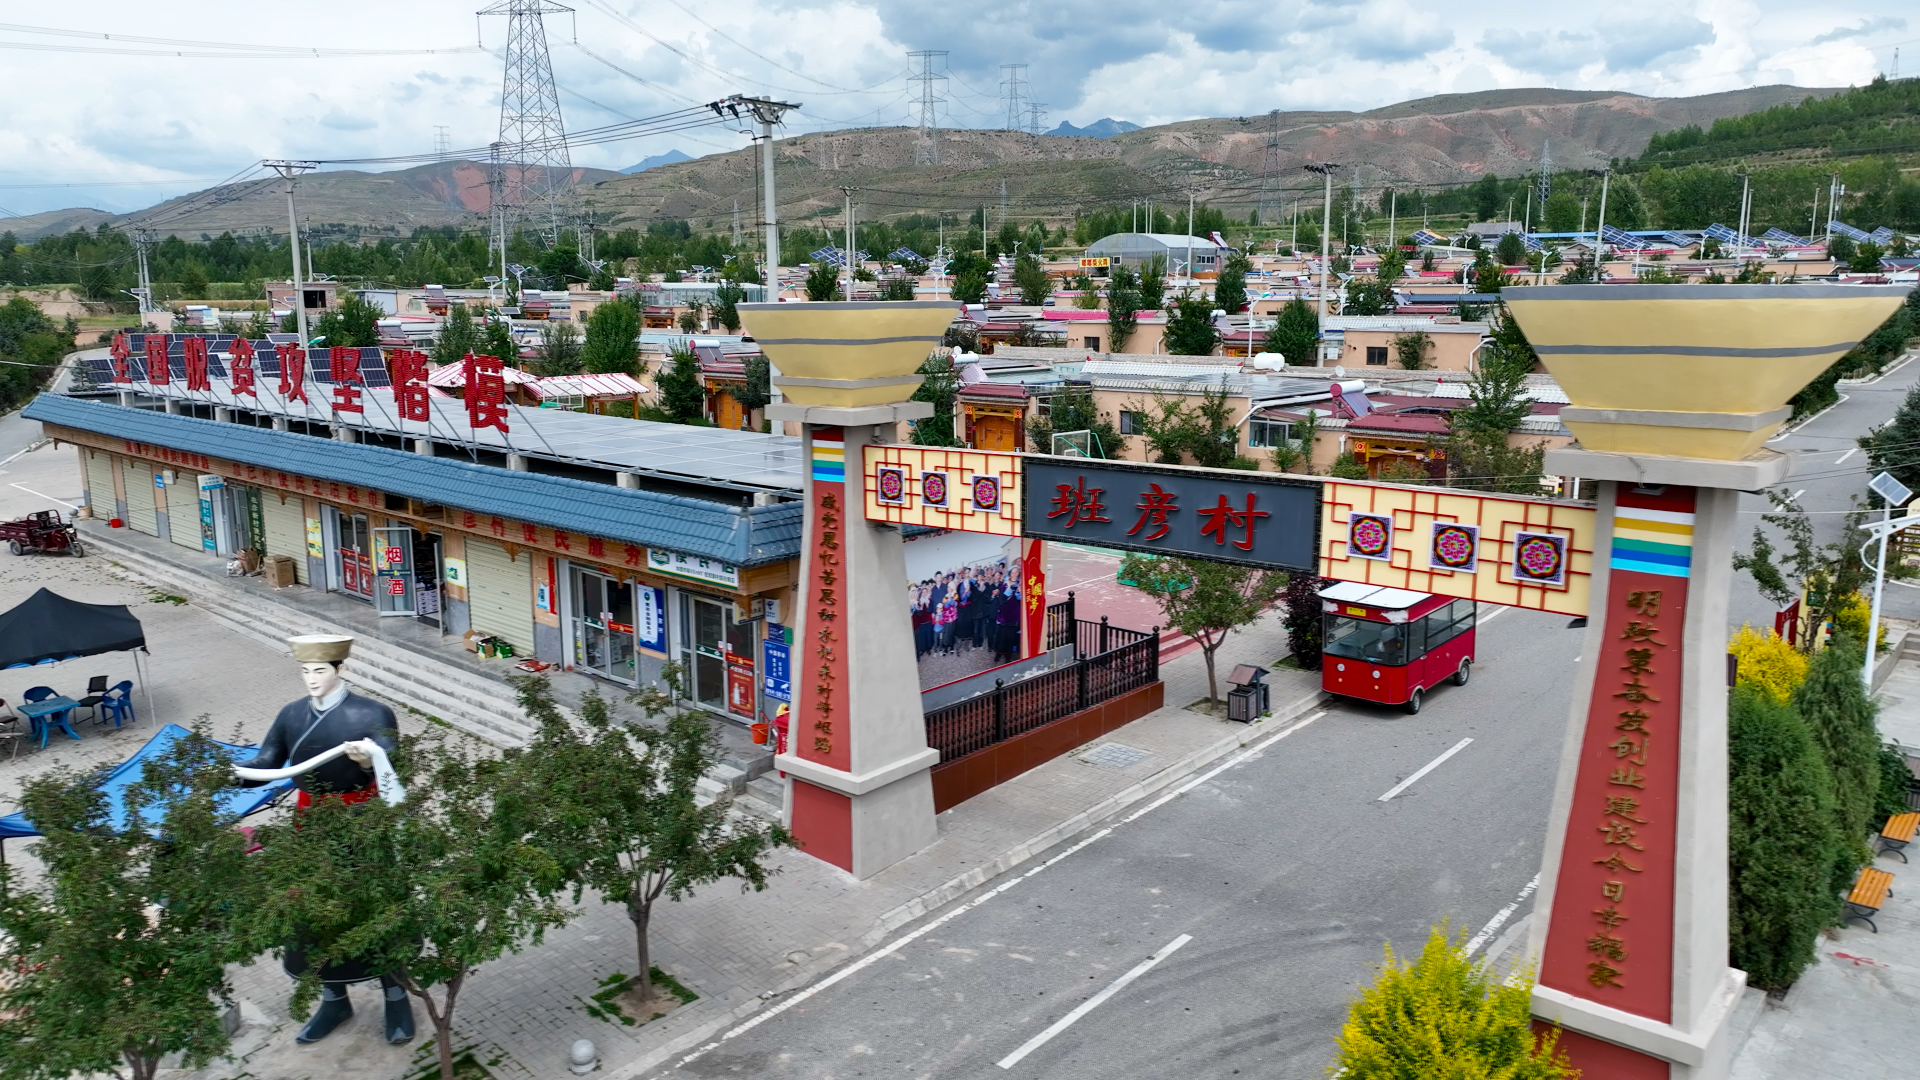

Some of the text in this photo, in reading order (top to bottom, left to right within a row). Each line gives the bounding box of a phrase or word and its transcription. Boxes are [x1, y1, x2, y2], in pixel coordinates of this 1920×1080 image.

[109, 333, 510, 433] 全国脱贫攻坚楷模
[1046, 475, 1271, 551] 班彦村
[1585, 589, 1668, 990] 明政策奋发创业建设今日幸福家
